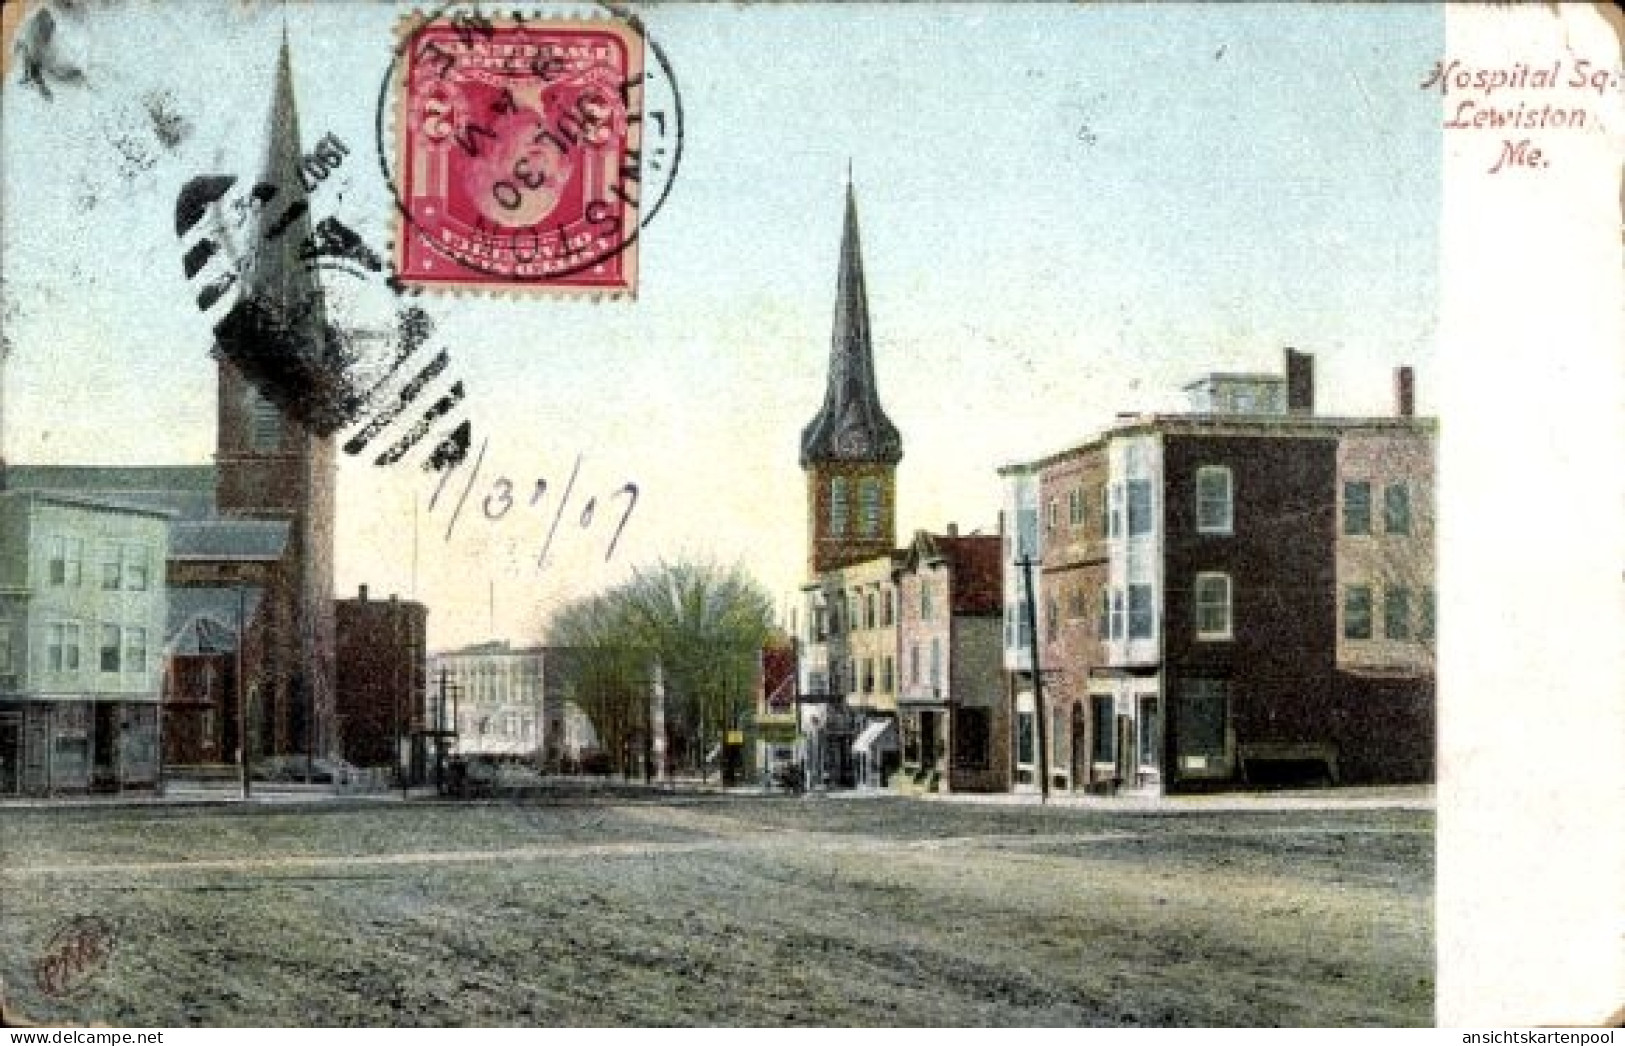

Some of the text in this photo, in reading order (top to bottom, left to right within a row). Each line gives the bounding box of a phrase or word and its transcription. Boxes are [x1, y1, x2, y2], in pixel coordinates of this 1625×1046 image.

[1420, 59, 1617, 95] Hospital Sq.
[1488, 138, 1550, 174] Me.
[493, 157, 546, 211] 30
